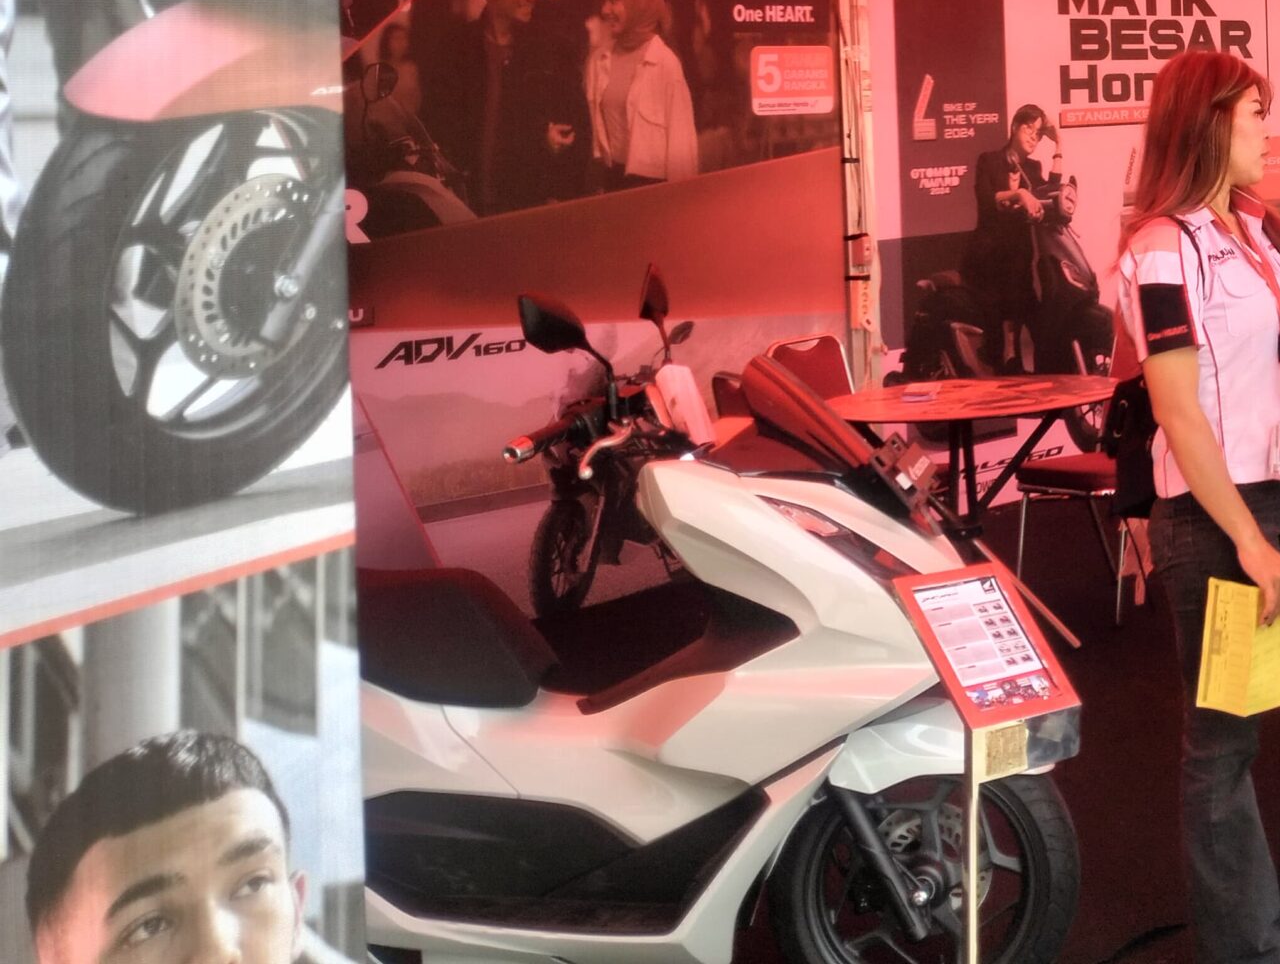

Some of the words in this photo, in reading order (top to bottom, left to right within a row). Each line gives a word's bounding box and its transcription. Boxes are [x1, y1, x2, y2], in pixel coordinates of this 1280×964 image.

[733, 4, 764, 22] One
[1069, 18, 1254, 61] BESAR
[757, 53, 782, 93] 5
[944, 114, 967, 125] THE
[969, 113, 1000, 124] YEAR
[1066, 110, 1129, 123] STANDAR
[943, 128, 975, 138] 2024
